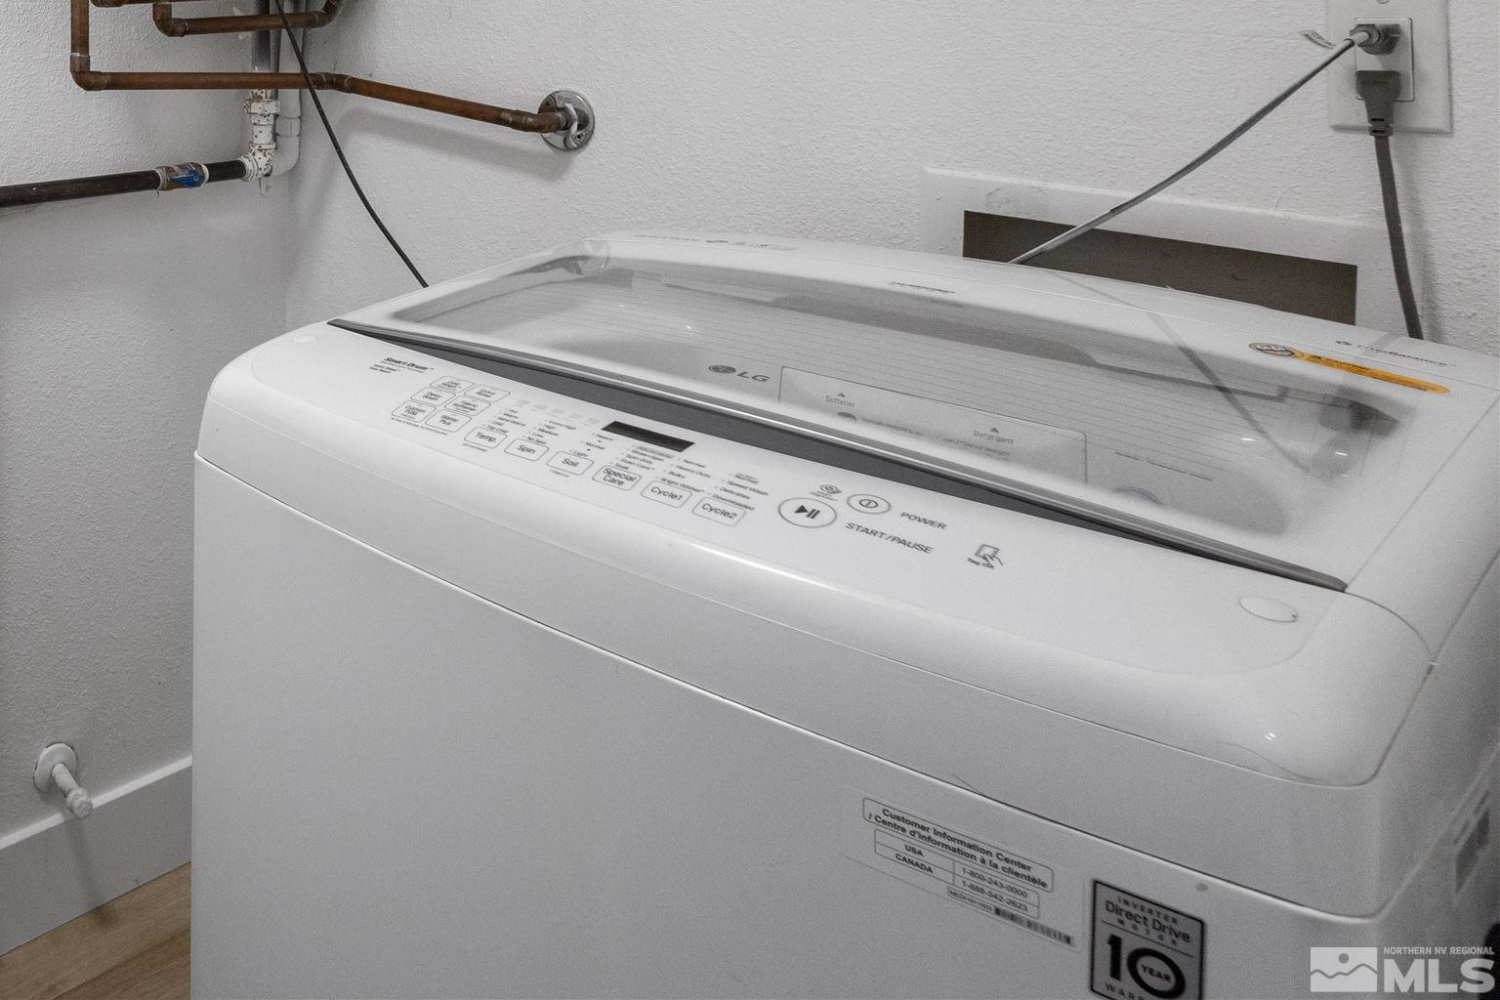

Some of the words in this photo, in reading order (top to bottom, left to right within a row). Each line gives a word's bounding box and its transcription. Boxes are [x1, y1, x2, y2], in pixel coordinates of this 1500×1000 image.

[738, 370, 771, 383] LG
[476, 431, 496, 443] Temp
[517, 444, 536, 454] Spin
[562, 458, 579, 467] Soil
[603, 467, 636, 481] Special
[603, 475, 625, 486] Care
[651, 486, 683, 501] Cycle1
[701, 503, 737, 520] Cycle2
[900, 511, 948, 530] POWER
[845, 522, 934, 554] START/PAUSE
[882, 807, 931, 833] Customer
[933, 828, 993, 858] Information
[996, 852, 1033, 872] Center
[874, 814, 907, 834] Centre
[909, 829, 977, 861] d'information
[979, 855, 986, 865] à
[989, 858, 999, 870] la
[1001, 866, 1048, 889] clientèle
[895, 852, 933, 874] CANADA
[904, 844, 924, 858] USA
[962, 867, 1028, 898] 1-800-243-0000
[1118, 896, 1178, 925] INVERTER
[1105, 900, 1149, 927] Direct
[1152, 918, 1190, 943] Drive
[1117, 918, 1178, 946] MOTOR
[1107, 933, 1186, 999] 10
[1141, 964, 1172, 983] YEAR
